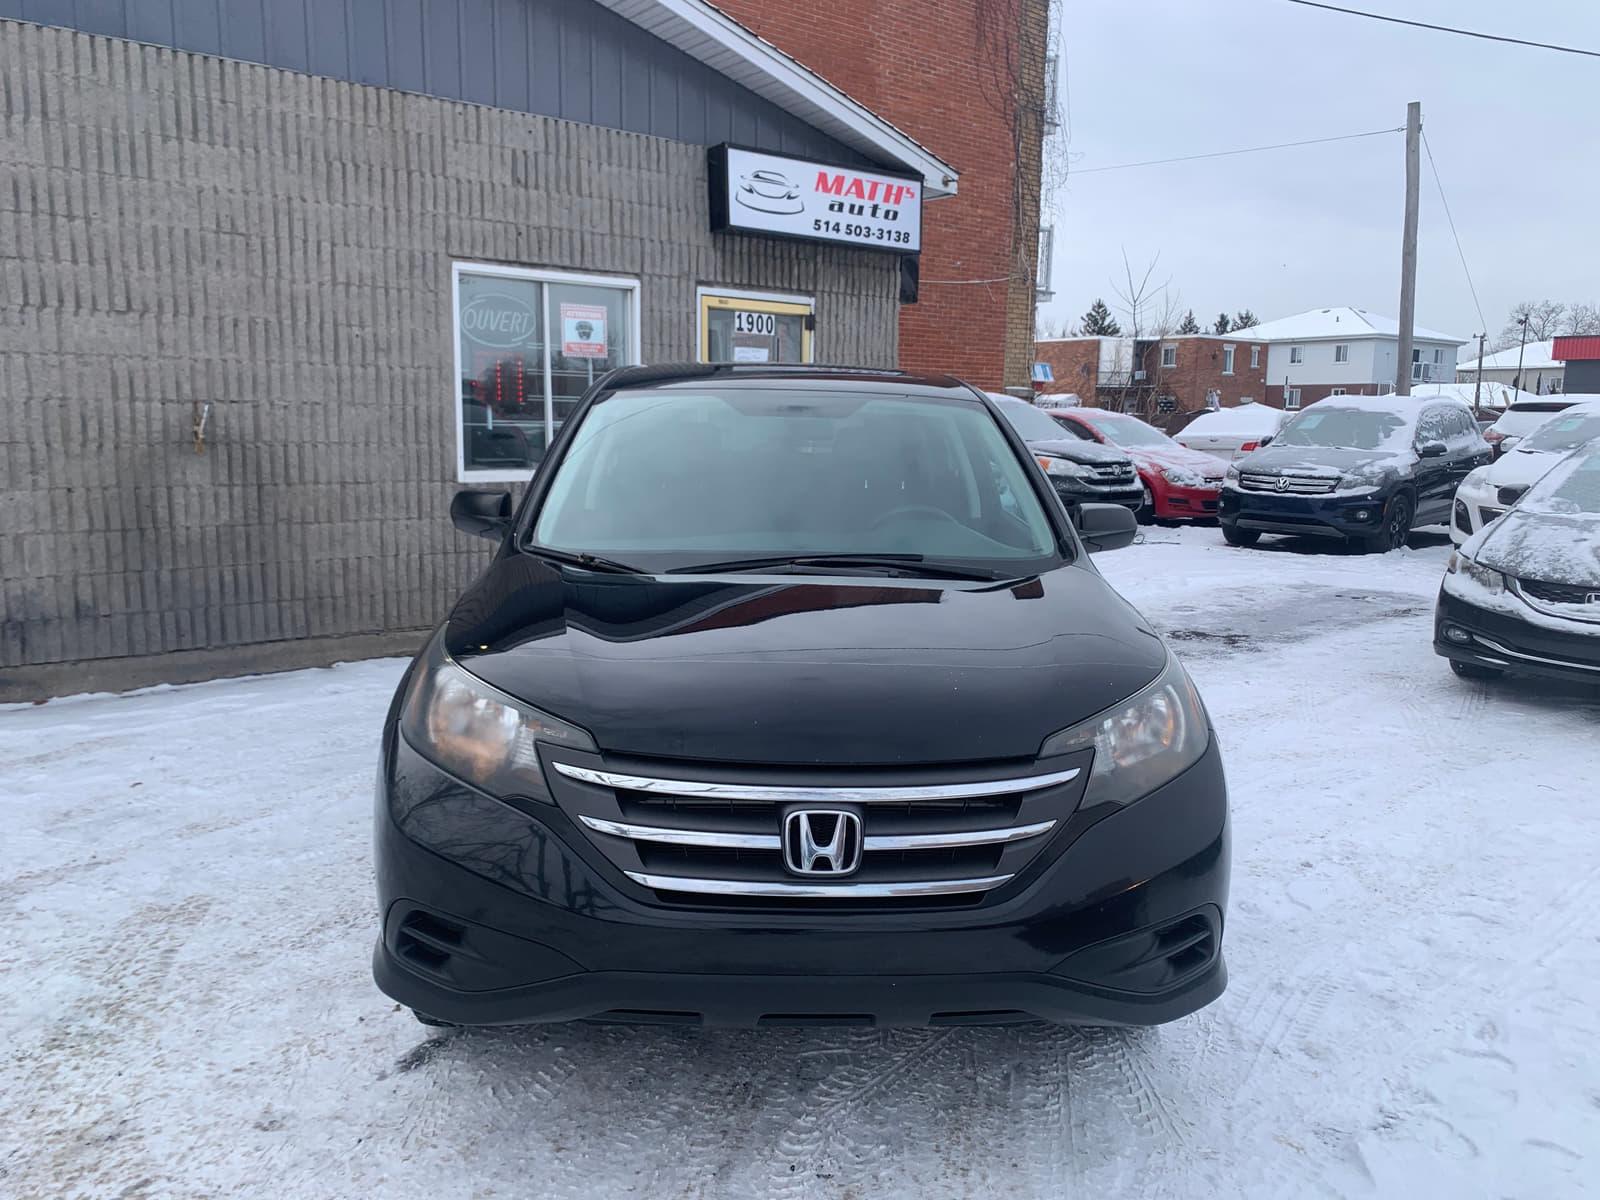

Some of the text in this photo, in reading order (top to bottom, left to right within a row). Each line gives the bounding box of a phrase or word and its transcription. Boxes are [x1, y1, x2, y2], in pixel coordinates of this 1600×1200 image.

[828, 200, 899, 221] auto
[813, 219, 911, 244] 514 503-3138
[463, 306, 530, 336] OUVERT
[736, 312, 774, 334] 1900
